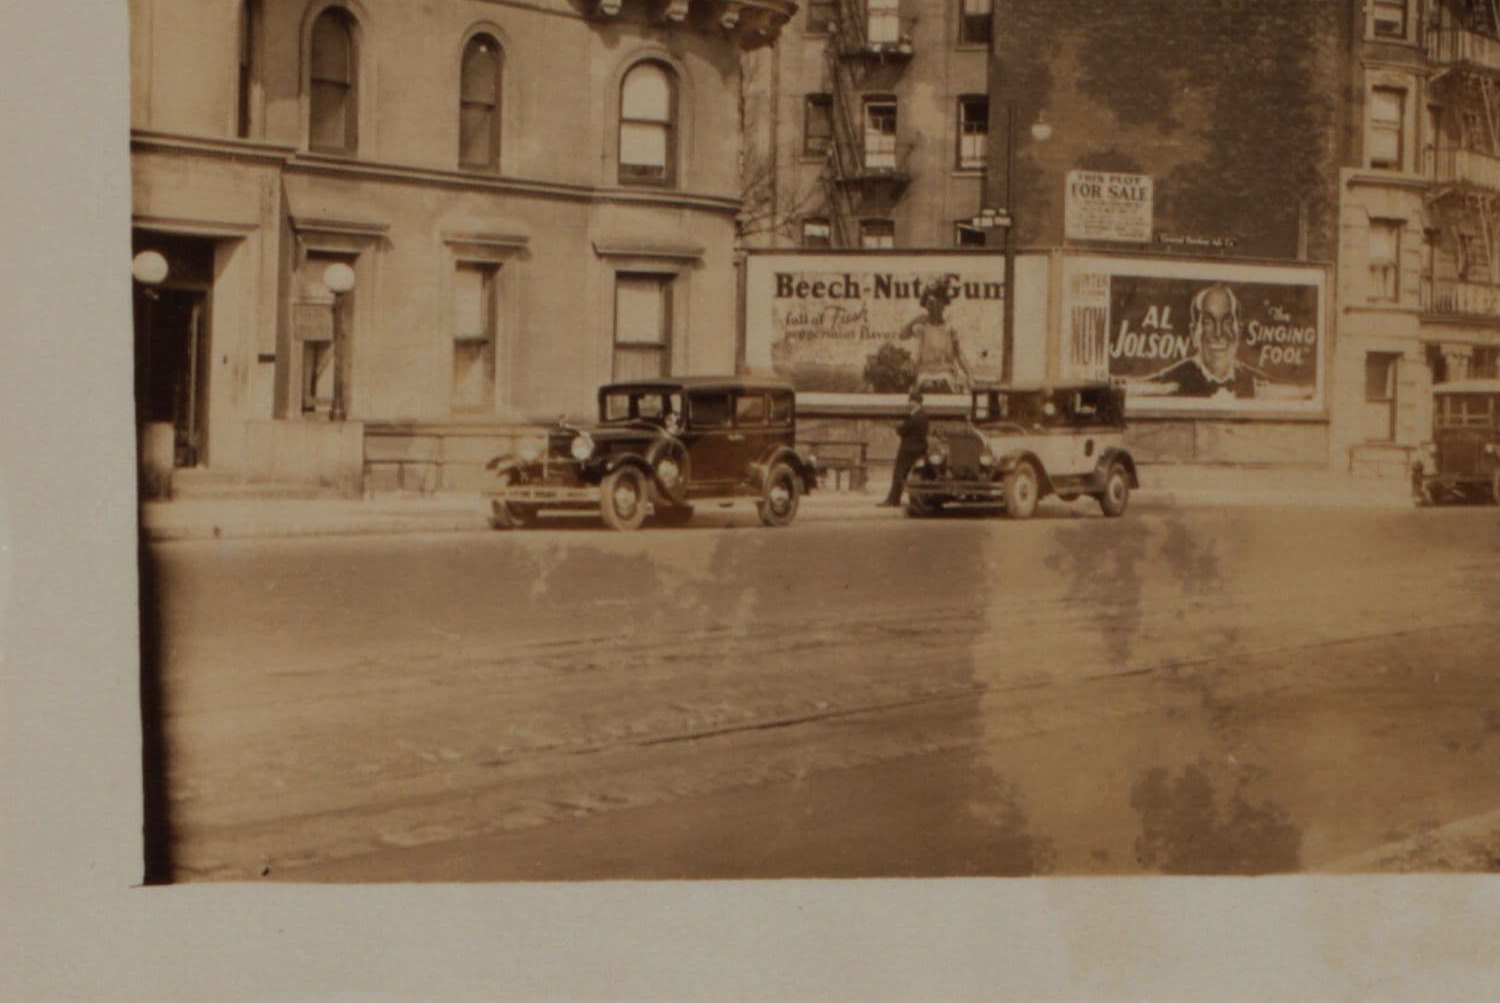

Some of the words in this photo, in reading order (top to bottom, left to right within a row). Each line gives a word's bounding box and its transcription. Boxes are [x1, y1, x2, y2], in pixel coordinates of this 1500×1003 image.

[1072, 182, 1101, 199] FOR
[1108, 185, 1146, 201] SALE
[774, 272, 921, 300] Beech-Nut
[1141, 304, 1174, 330] AL
[1109, 319, 1191, 359] JOLSON
[1246, 319, 1316, 346] SINGING
